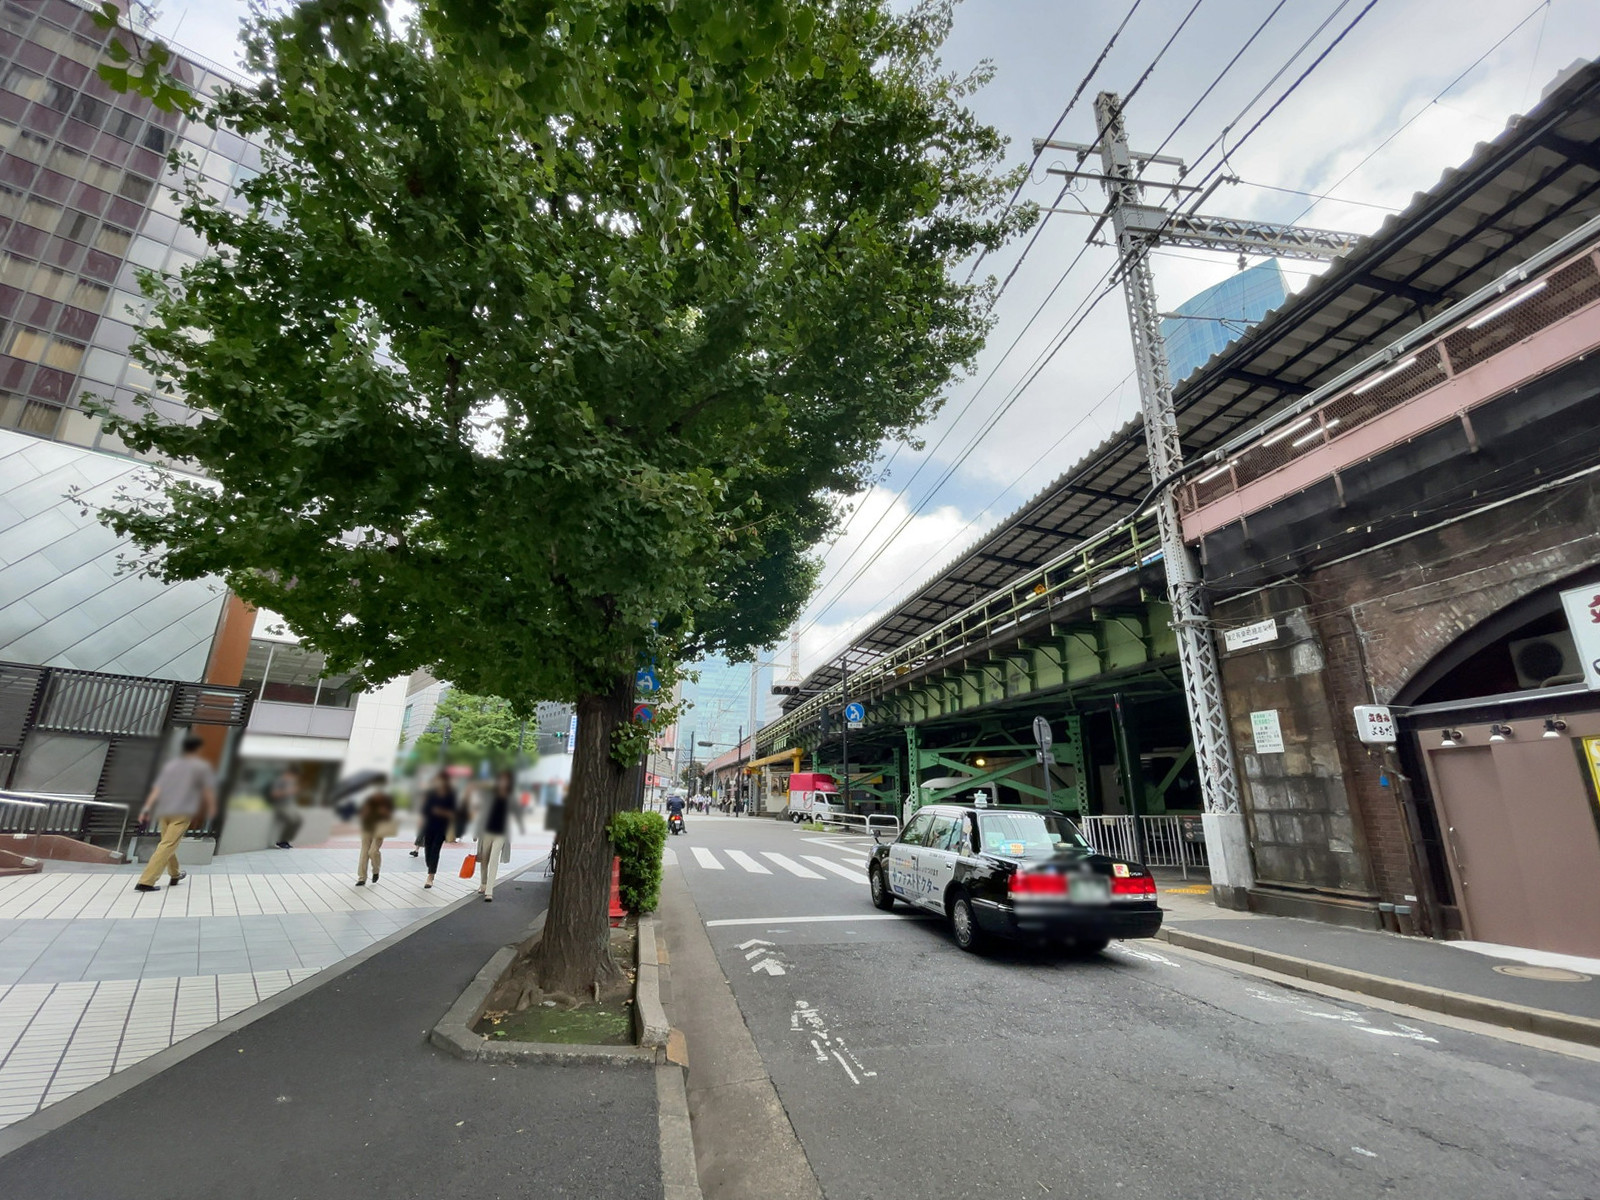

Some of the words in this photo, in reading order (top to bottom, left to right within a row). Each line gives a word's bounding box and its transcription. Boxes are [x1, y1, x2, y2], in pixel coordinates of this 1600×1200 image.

[897, 870, 939, 893] ファストドクター
